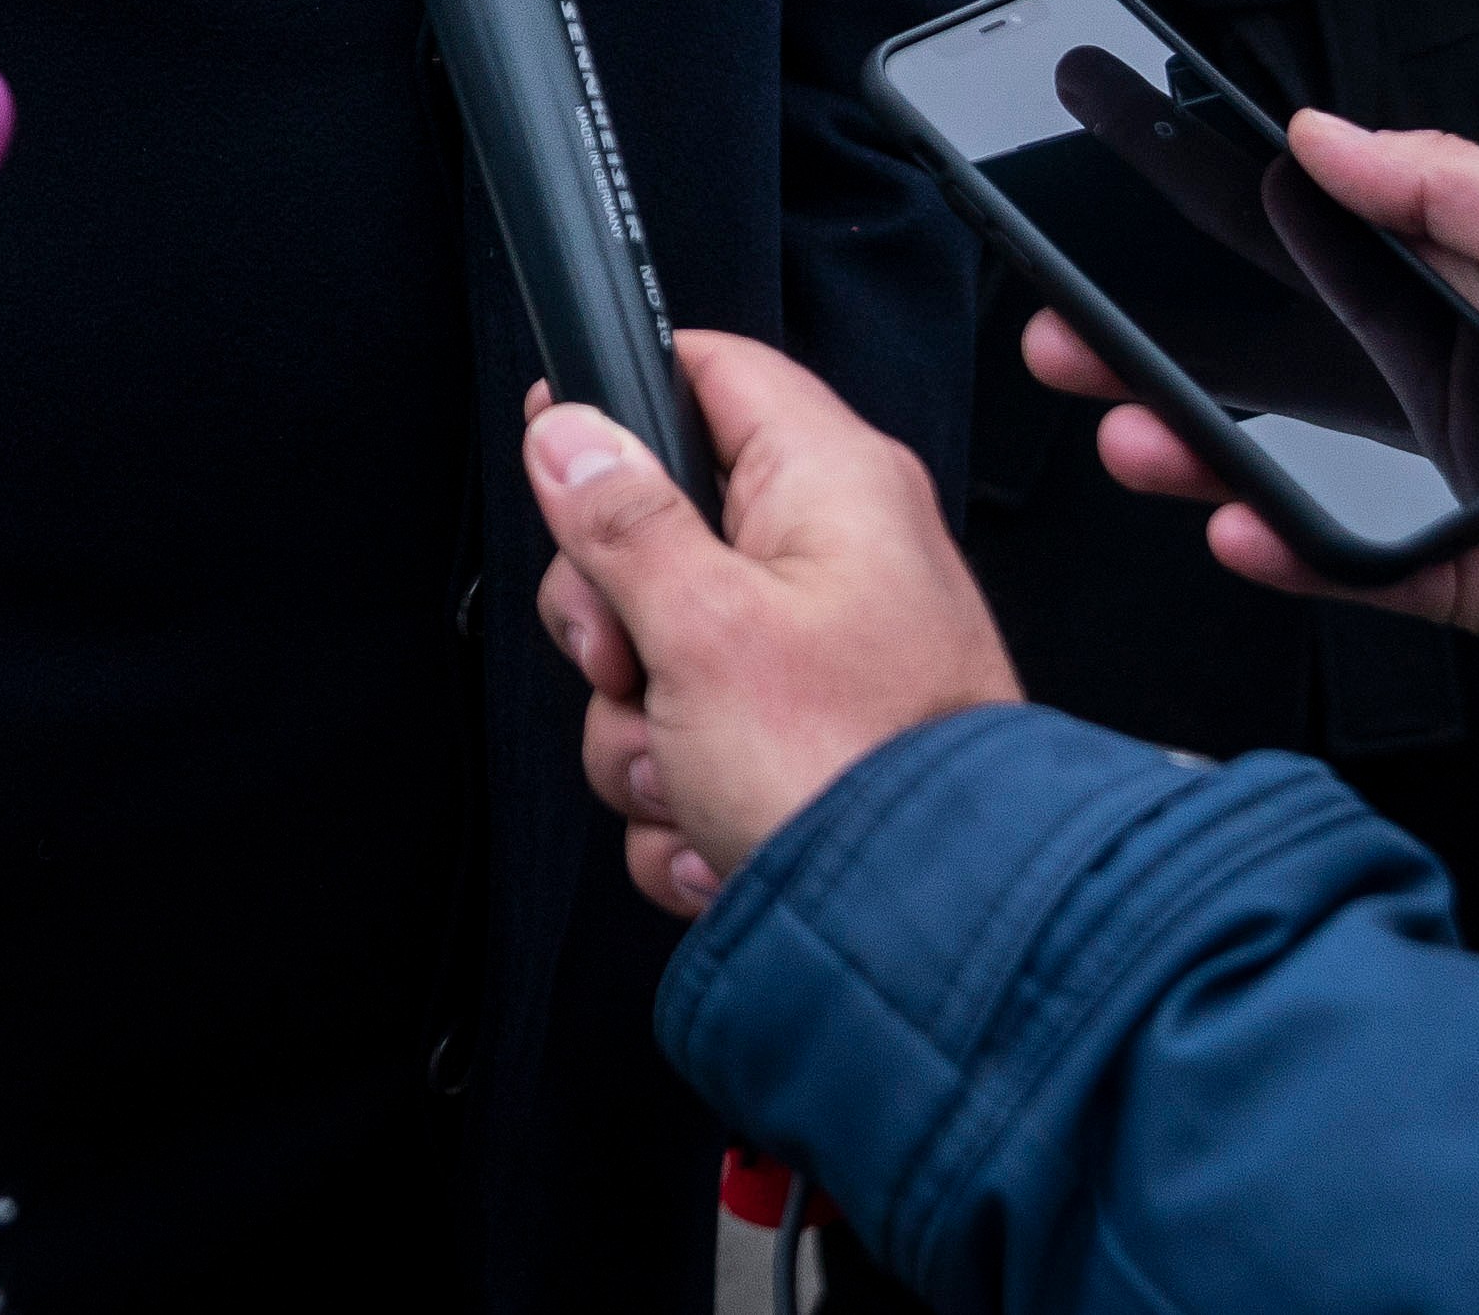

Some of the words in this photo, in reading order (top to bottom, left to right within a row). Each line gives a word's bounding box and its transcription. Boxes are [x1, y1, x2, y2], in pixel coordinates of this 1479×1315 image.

[561, 0, 642, 243] SENNHEISER
[640, 265, 661, 308] MD
[575, 105, 596, 148] MADE
[588, 150, 601, 166] IN
[594, 168, 624, 238] GERMANY
